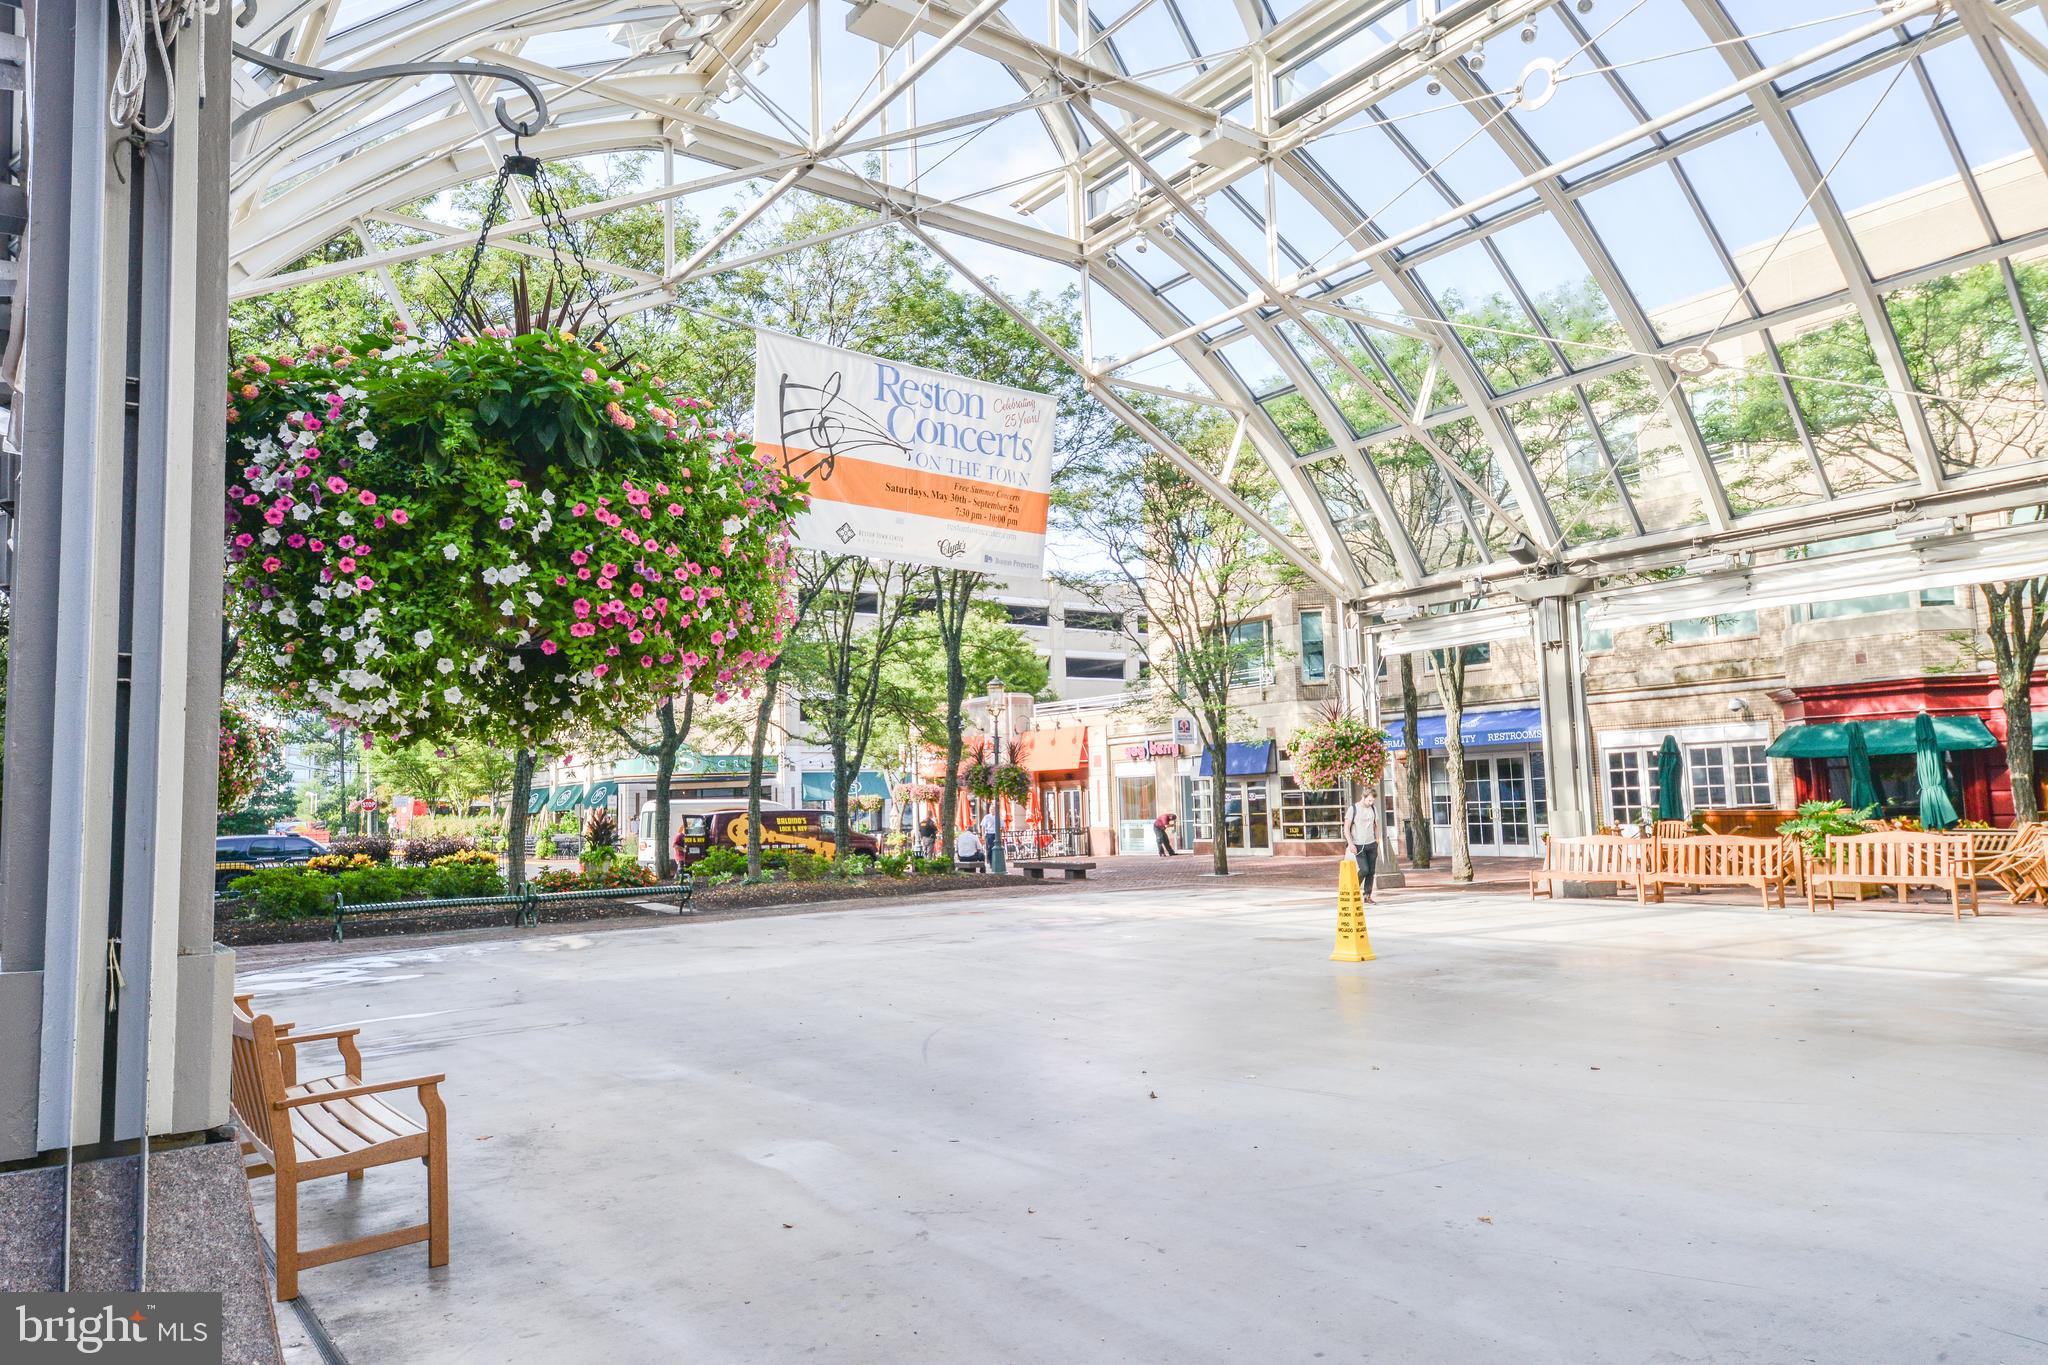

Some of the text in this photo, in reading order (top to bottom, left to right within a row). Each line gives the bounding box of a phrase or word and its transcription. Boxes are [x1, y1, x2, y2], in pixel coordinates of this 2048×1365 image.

[873, 362, 986, 420] Reston
[993, 398, 1036, 414] Celebrating
[1004, 413, 1017, 428] 25
[887, 404, 1033, 463] Concerts
[915, 452, 1031, 486] ON THE TOWN
[885, 482, 929, 499] Saturdays,
[931, 489, 949, 503] May
[949, 493, 967, 504] 30th
[972, 496, 1007, 513] September
[1008, 504, 1020, 514] 5th
[953, 482, 1021, 501] Free Summer Concerts
[955, 507, 970, 518] 7:30
[970, 511, 983, 521] pm
[988, 513, 1006, 524] 10:00
[1006, 517, 1019, 527] pm
[1434, 734, 1476, 746] SECITY
[1487, 729, 1542, 742] RESTROOMS
